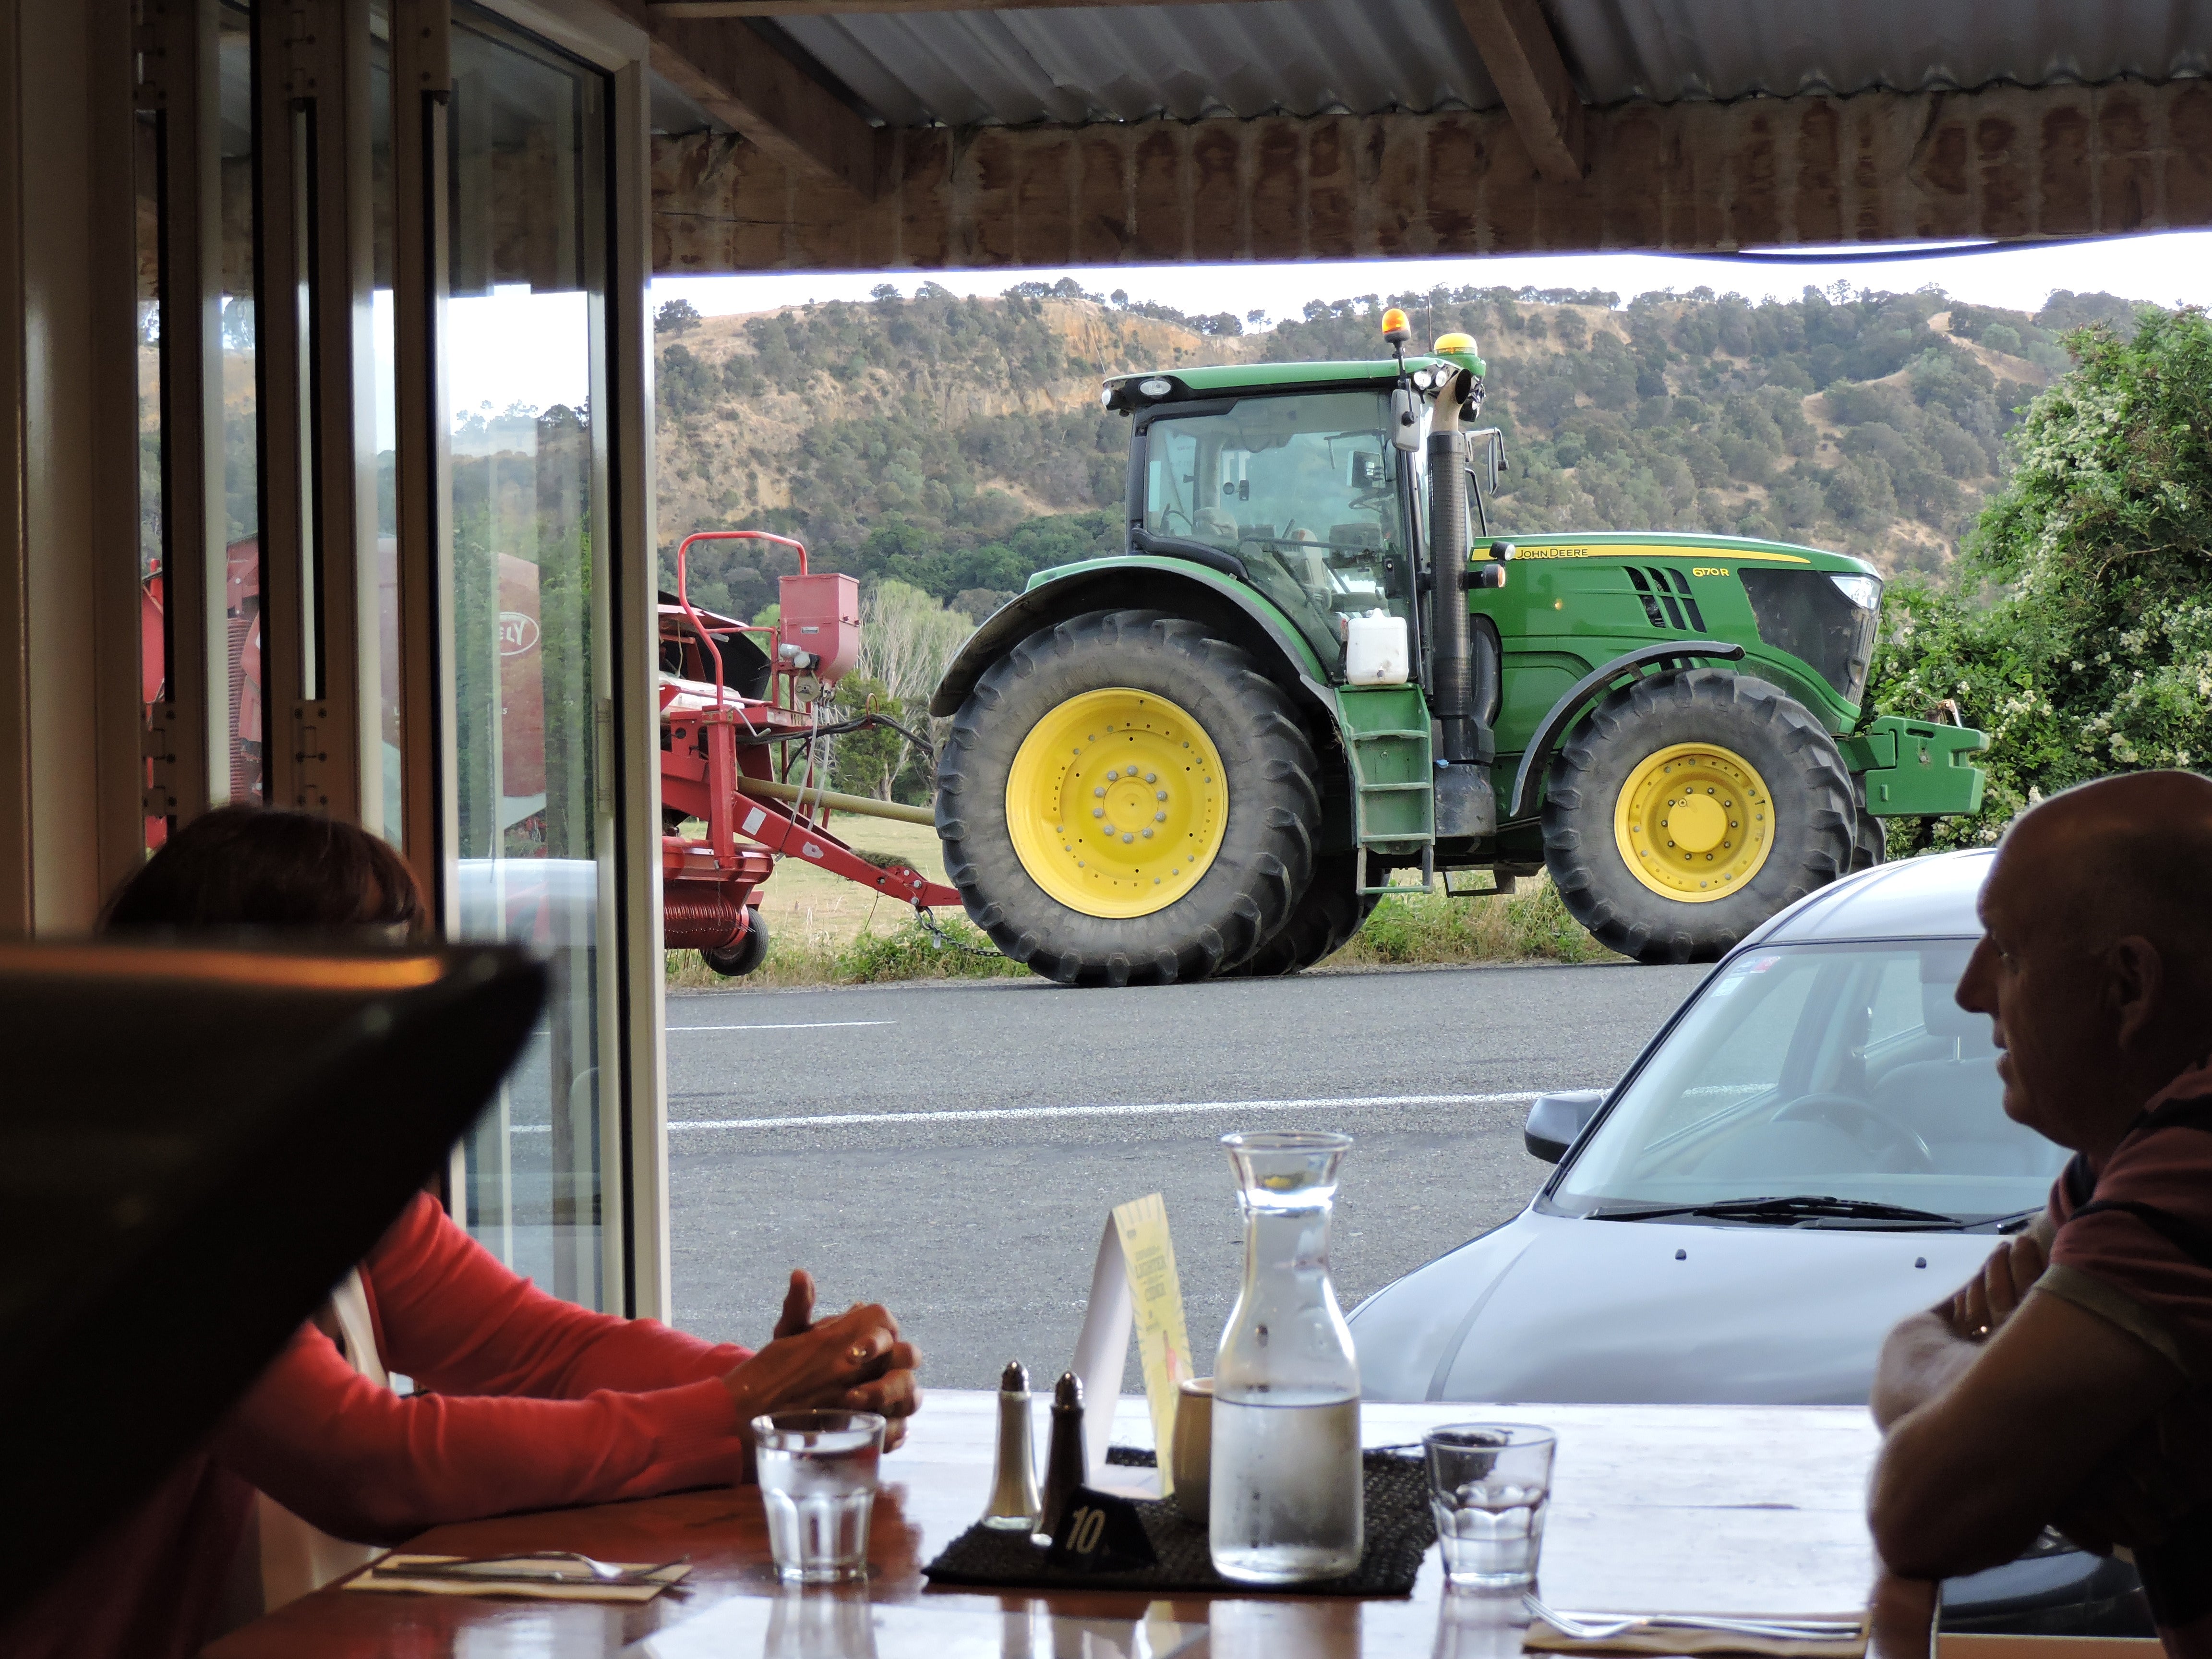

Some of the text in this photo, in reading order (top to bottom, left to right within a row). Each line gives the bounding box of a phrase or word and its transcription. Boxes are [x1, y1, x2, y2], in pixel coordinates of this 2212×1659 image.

[1517, 548, 1588, 558] JOHN DEERE
[1065, 1505, 1105, 1554] 10
